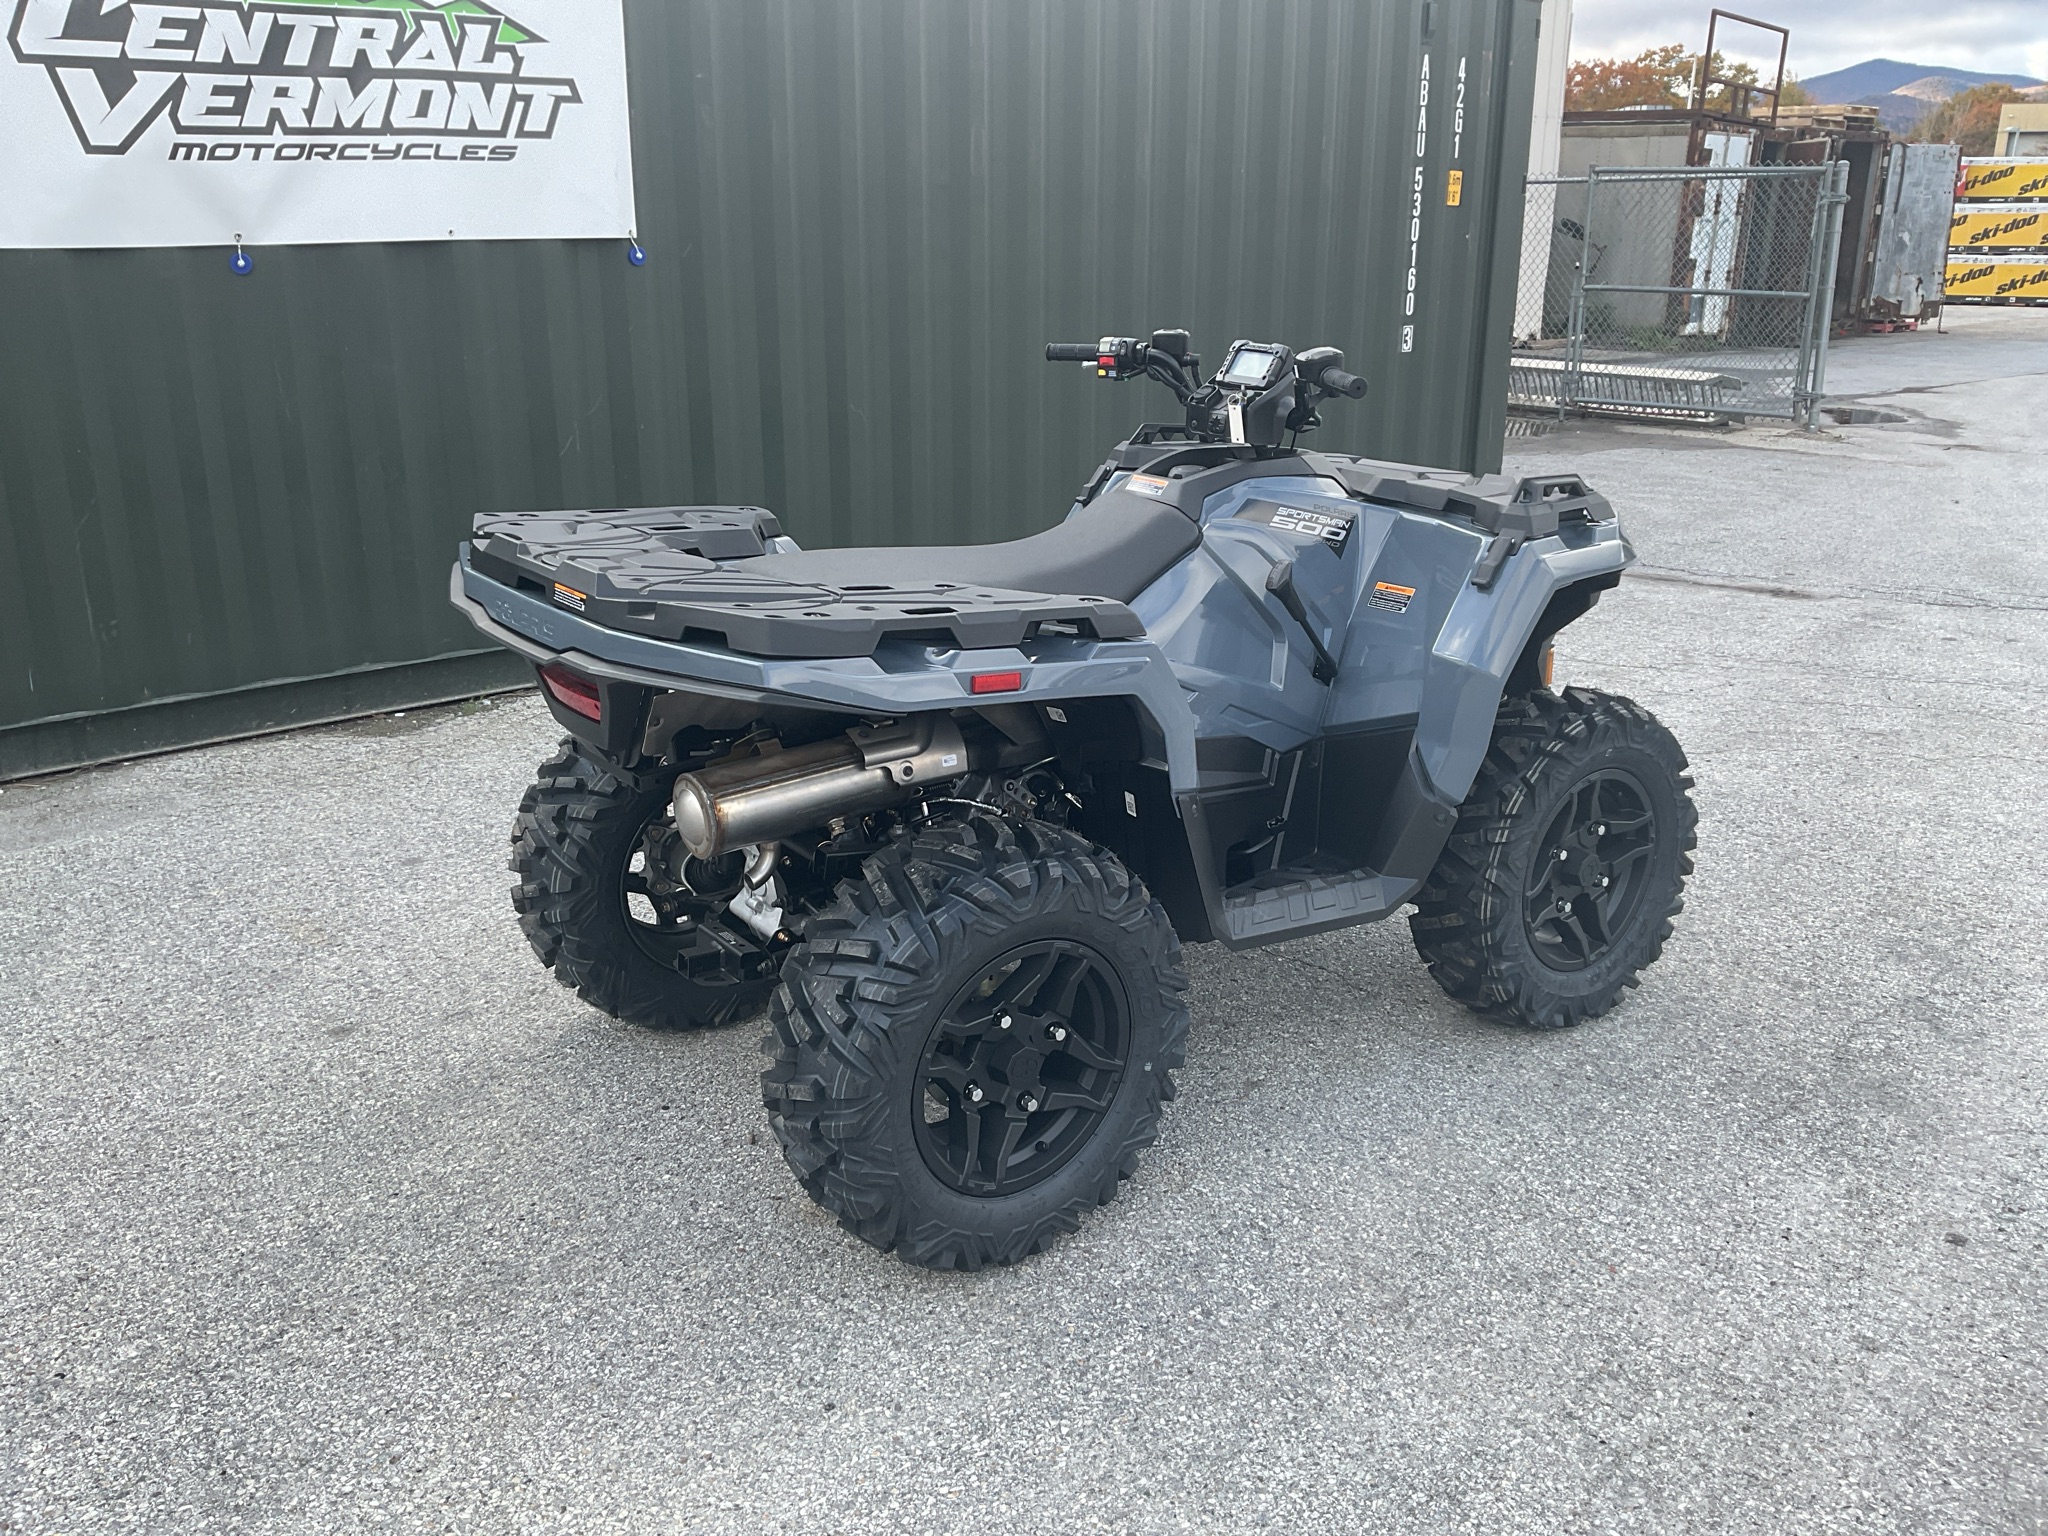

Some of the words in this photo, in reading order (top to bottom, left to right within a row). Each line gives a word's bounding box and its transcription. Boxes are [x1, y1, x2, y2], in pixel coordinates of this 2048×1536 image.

[54, 65, 573, 149] VERMONT
[1416, 53, 1430, 158] ABAU
[1454, 56, 1466, 159] 42G1
[167, 140, 519, 163] MOTORCYCLES
[1404, 165, 1424, 317] 530160
[1968, 214, 2040, 245] ski-doo
[1269, 515, 1347, 541] 500
[1276, 506, 1351, 529] SPORTSMAN
